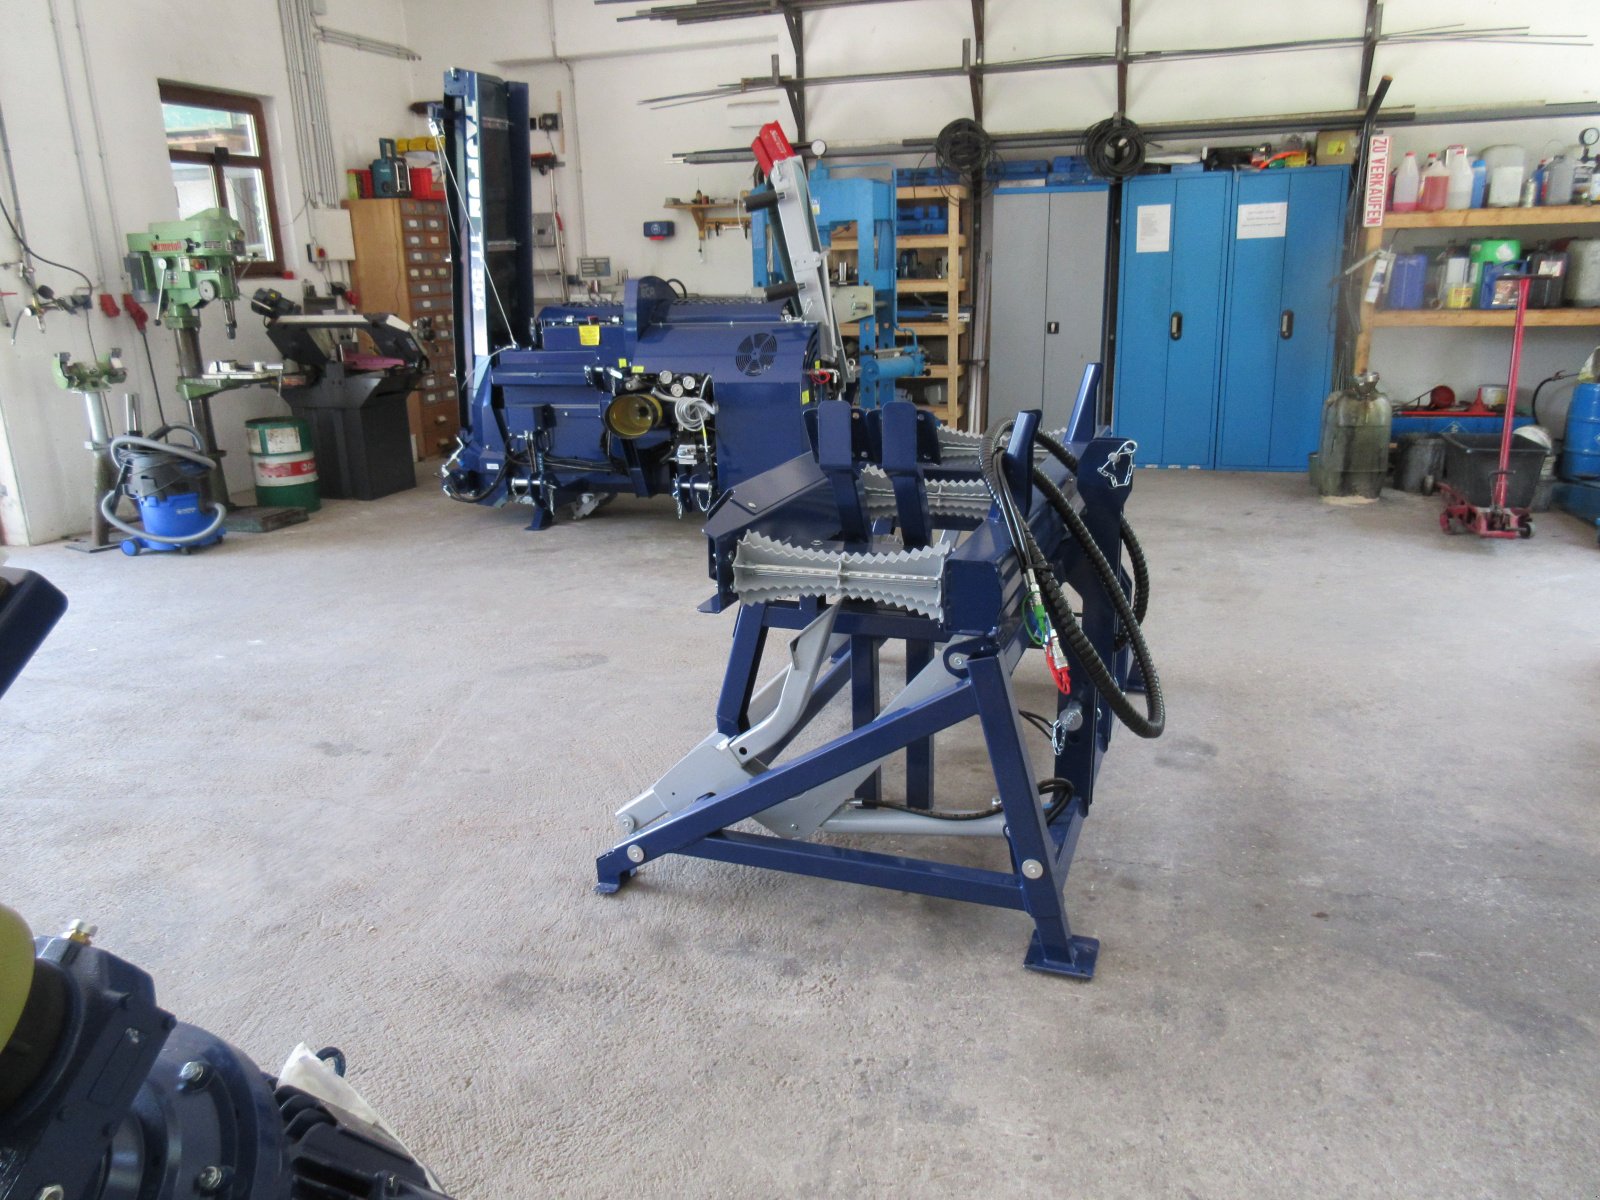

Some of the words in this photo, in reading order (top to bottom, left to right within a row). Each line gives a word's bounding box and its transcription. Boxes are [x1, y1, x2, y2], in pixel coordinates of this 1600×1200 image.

[465, 101, 482, 218] TAJFUN
[1372, 138, 1387, 153] ZU
[1366, 158, 1386, 224] VERKAUFEN
